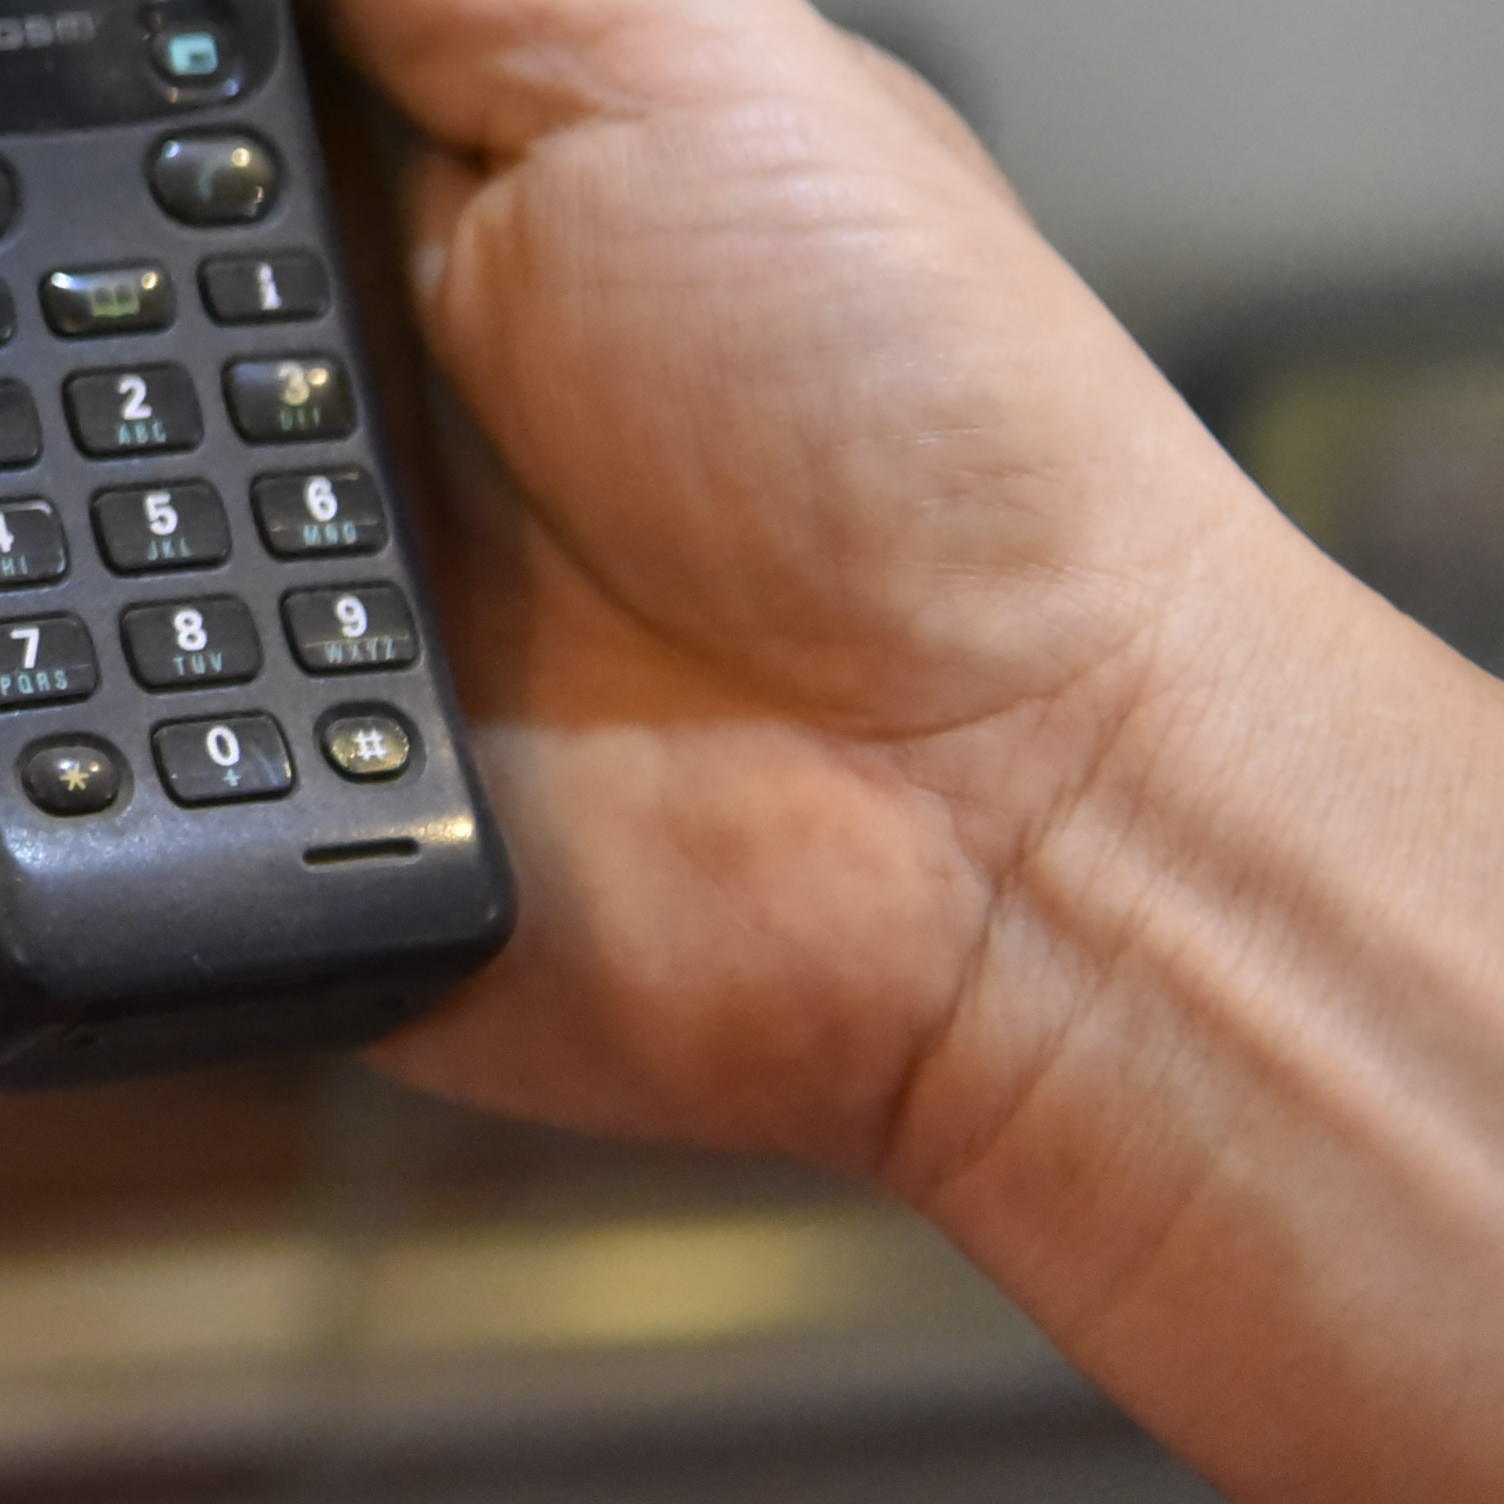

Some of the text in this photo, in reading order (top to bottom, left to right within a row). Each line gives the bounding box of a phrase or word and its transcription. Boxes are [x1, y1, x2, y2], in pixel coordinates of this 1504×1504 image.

[118, 375, 151, 421] 2
[145, 493, 177, 537] 5
[305, 476, 337, 522] 6
[175, 609, 207, 653] 8
[335, 597, 368, 638] 9
[11, 628, 40, 669] 7
[206, 726, 240, 767] 0
